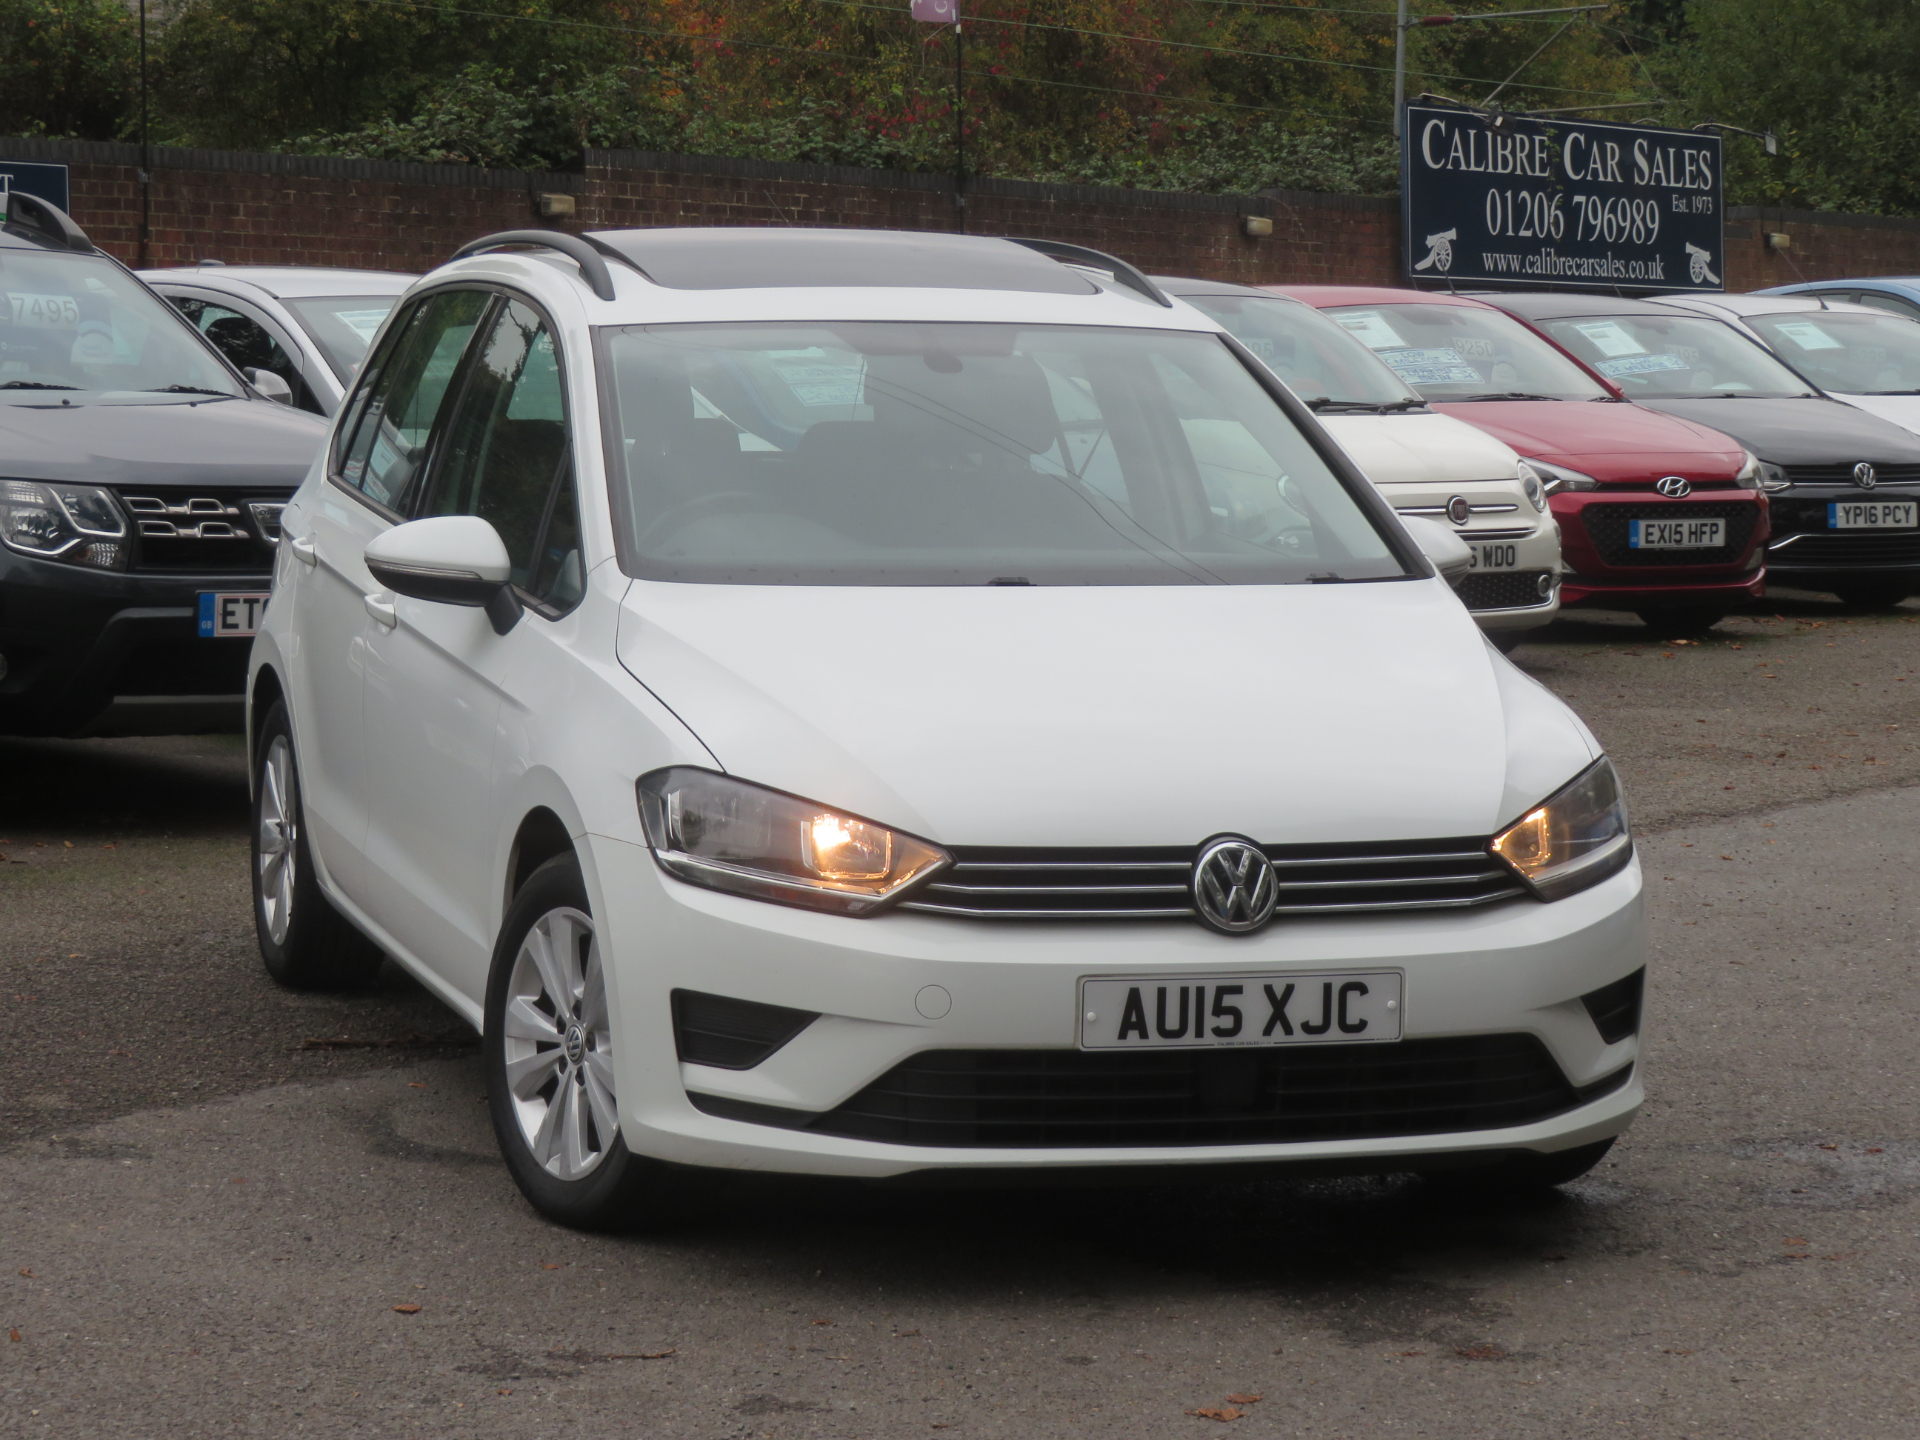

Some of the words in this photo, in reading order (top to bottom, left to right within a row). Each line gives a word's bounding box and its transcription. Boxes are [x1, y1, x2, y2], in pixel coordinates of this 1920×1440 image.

[1422, 118, 1550, 177] CALIBRE
[1563, 132, 1624, 183] CAR
[1633, 138, 1713, 191] SALES
[1671, 194, 1689, 213] Est.
[1691, 195, 1713, 214] 1973
[1486, 188, 1564, 239] 01206
[1571, 195, 1660, 245] 796989
[1482, 247, 1665, 280] www.calibrecarsales.co.uk
[1400, 351, 1425, 359] LOW
[1842, 505, 1878, 525] YP16
[1882, 505, 1912, 524] PCY
[1645, 523, 1683, 545] EX15
[1688, 522, 1719, 543] HFP
[1482, 545, 1516, 568] WDO
[201, 620, 213, 630] GB
[222, 597, 270, 630] ET
[1117, 984, 1244, 1040] AU15
[1262, 981, 1369, 1037] XJC
